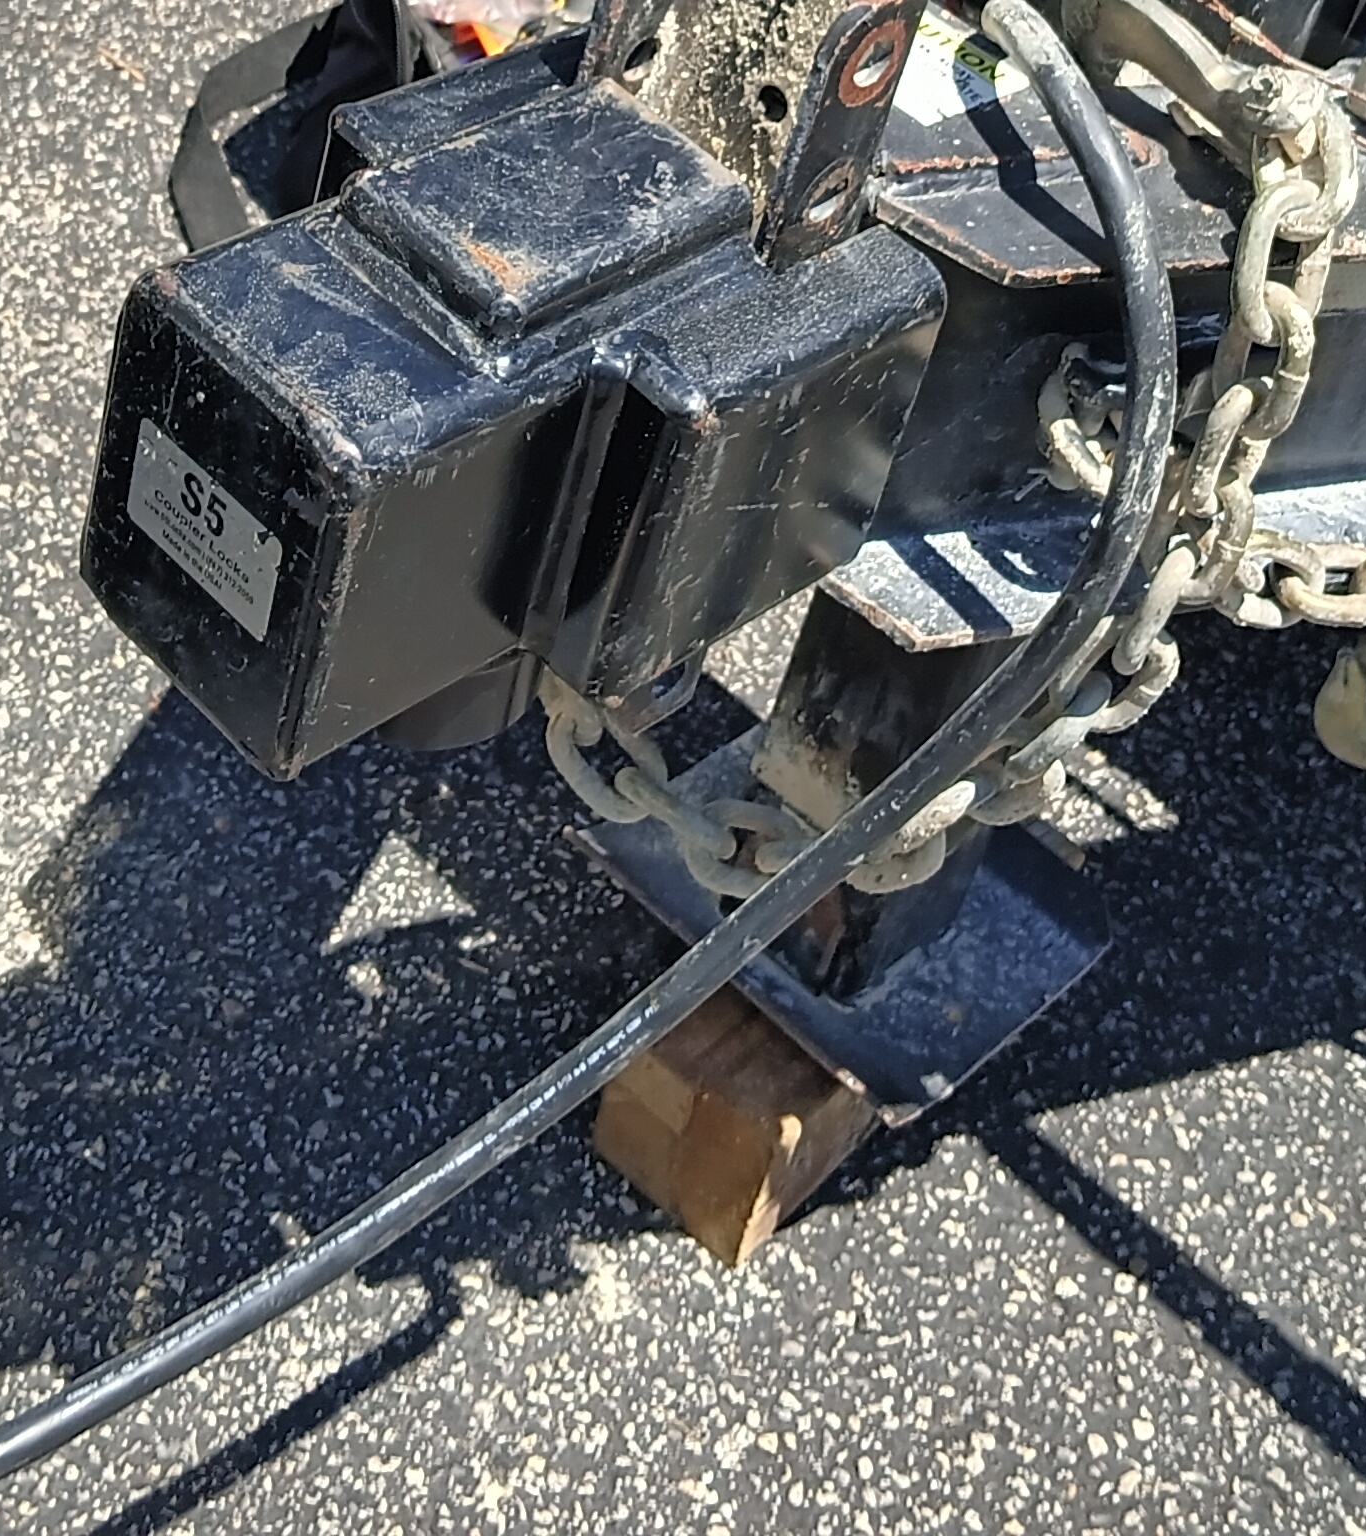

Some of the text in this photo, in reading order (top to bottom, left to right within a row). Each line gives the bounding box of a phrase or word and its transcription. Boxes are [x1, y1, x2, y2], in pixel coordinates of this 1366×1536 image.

[918, 23, 1005, 81] UTION
[155, 489, 250, 584] Coupler Locks
[180, 472, 227, 537] S5
